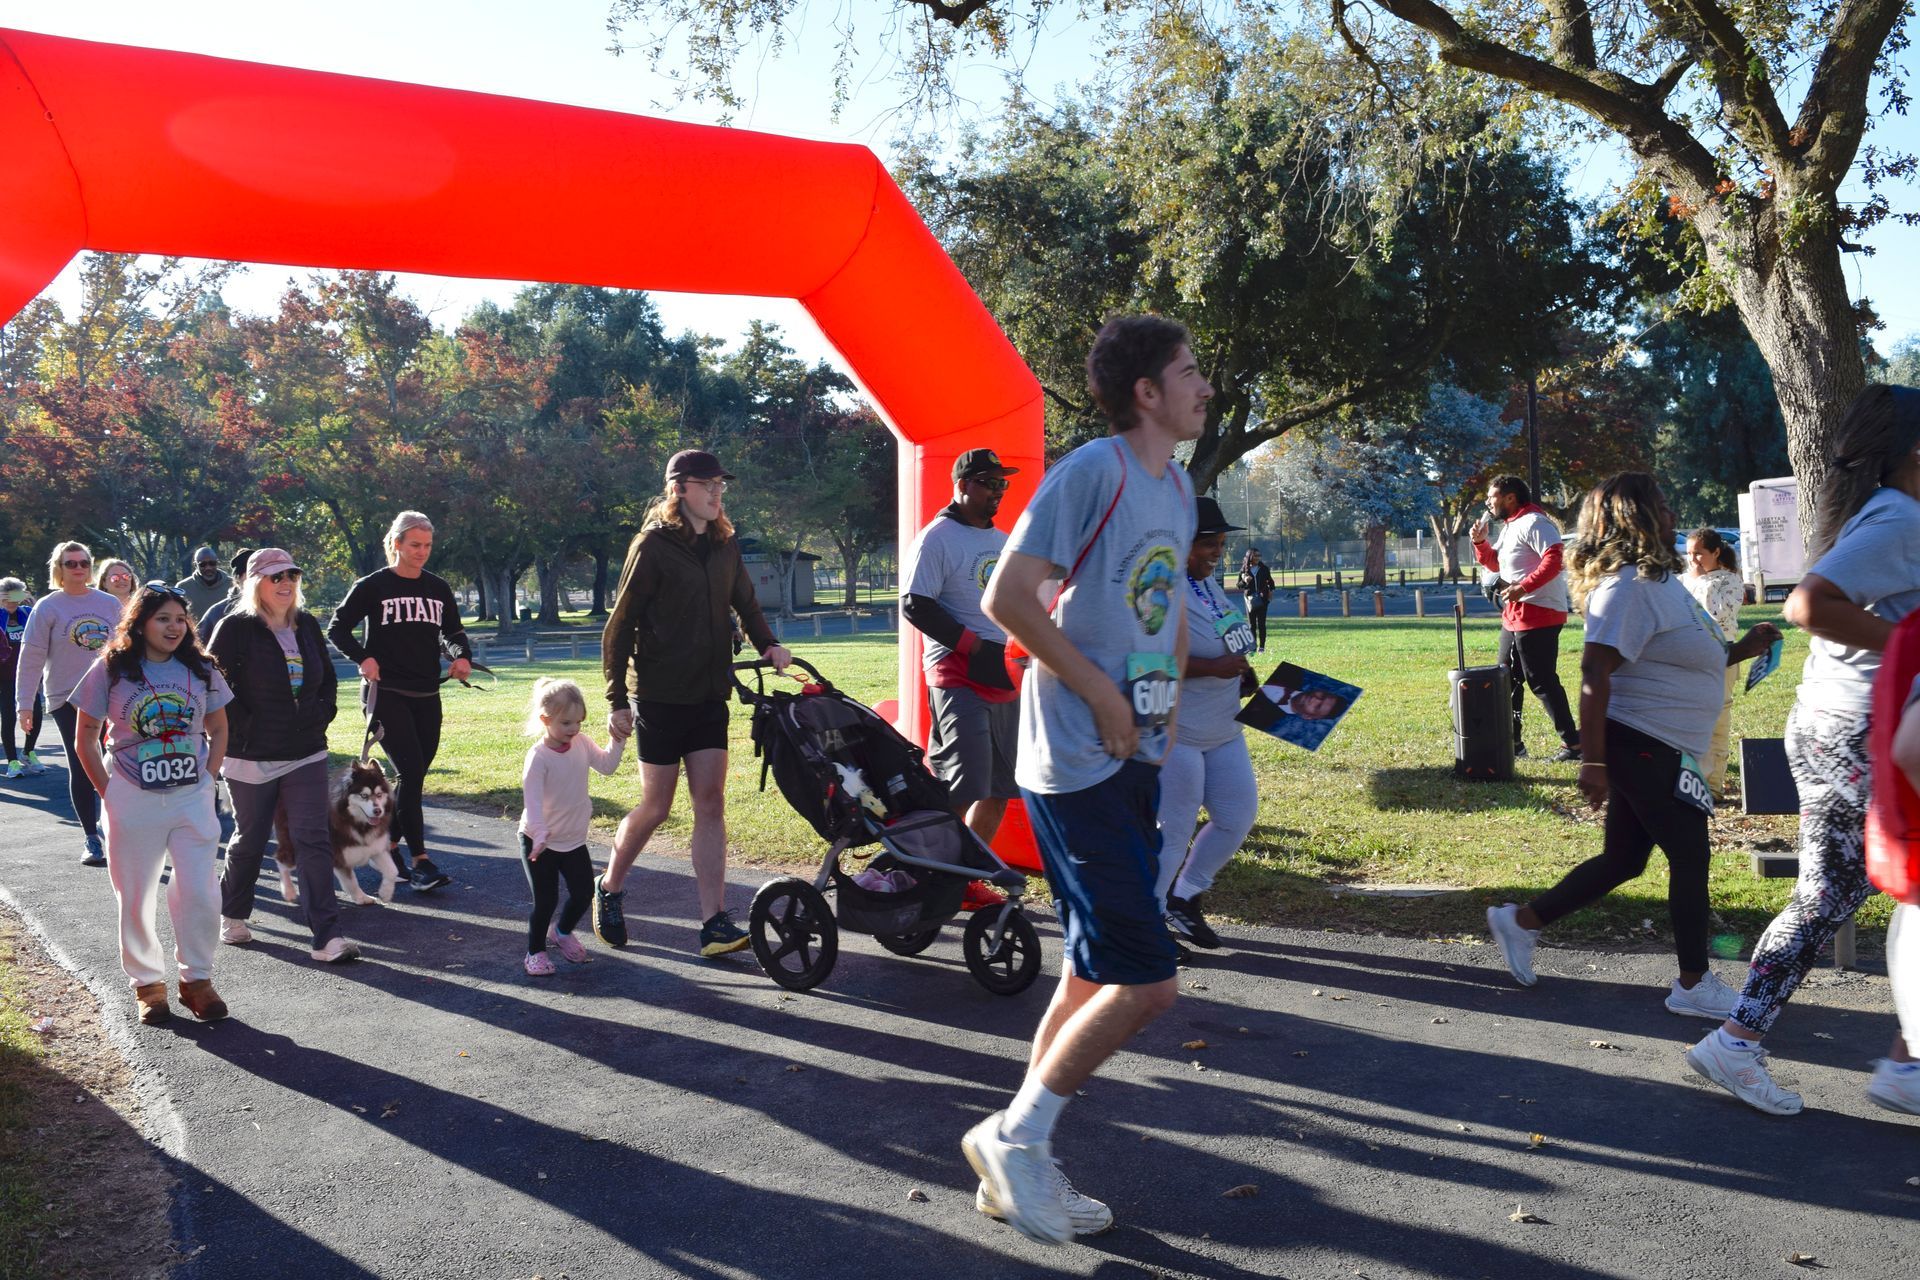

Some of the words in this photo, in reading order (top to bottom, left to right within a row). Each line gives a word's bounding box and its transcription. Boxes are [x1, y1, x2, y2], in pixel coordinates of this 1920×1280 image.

[1224, 624, 1254, 653] 6016
[119, 692, 140, 721] Lamont
[141, 757, 197, 783] 6032
